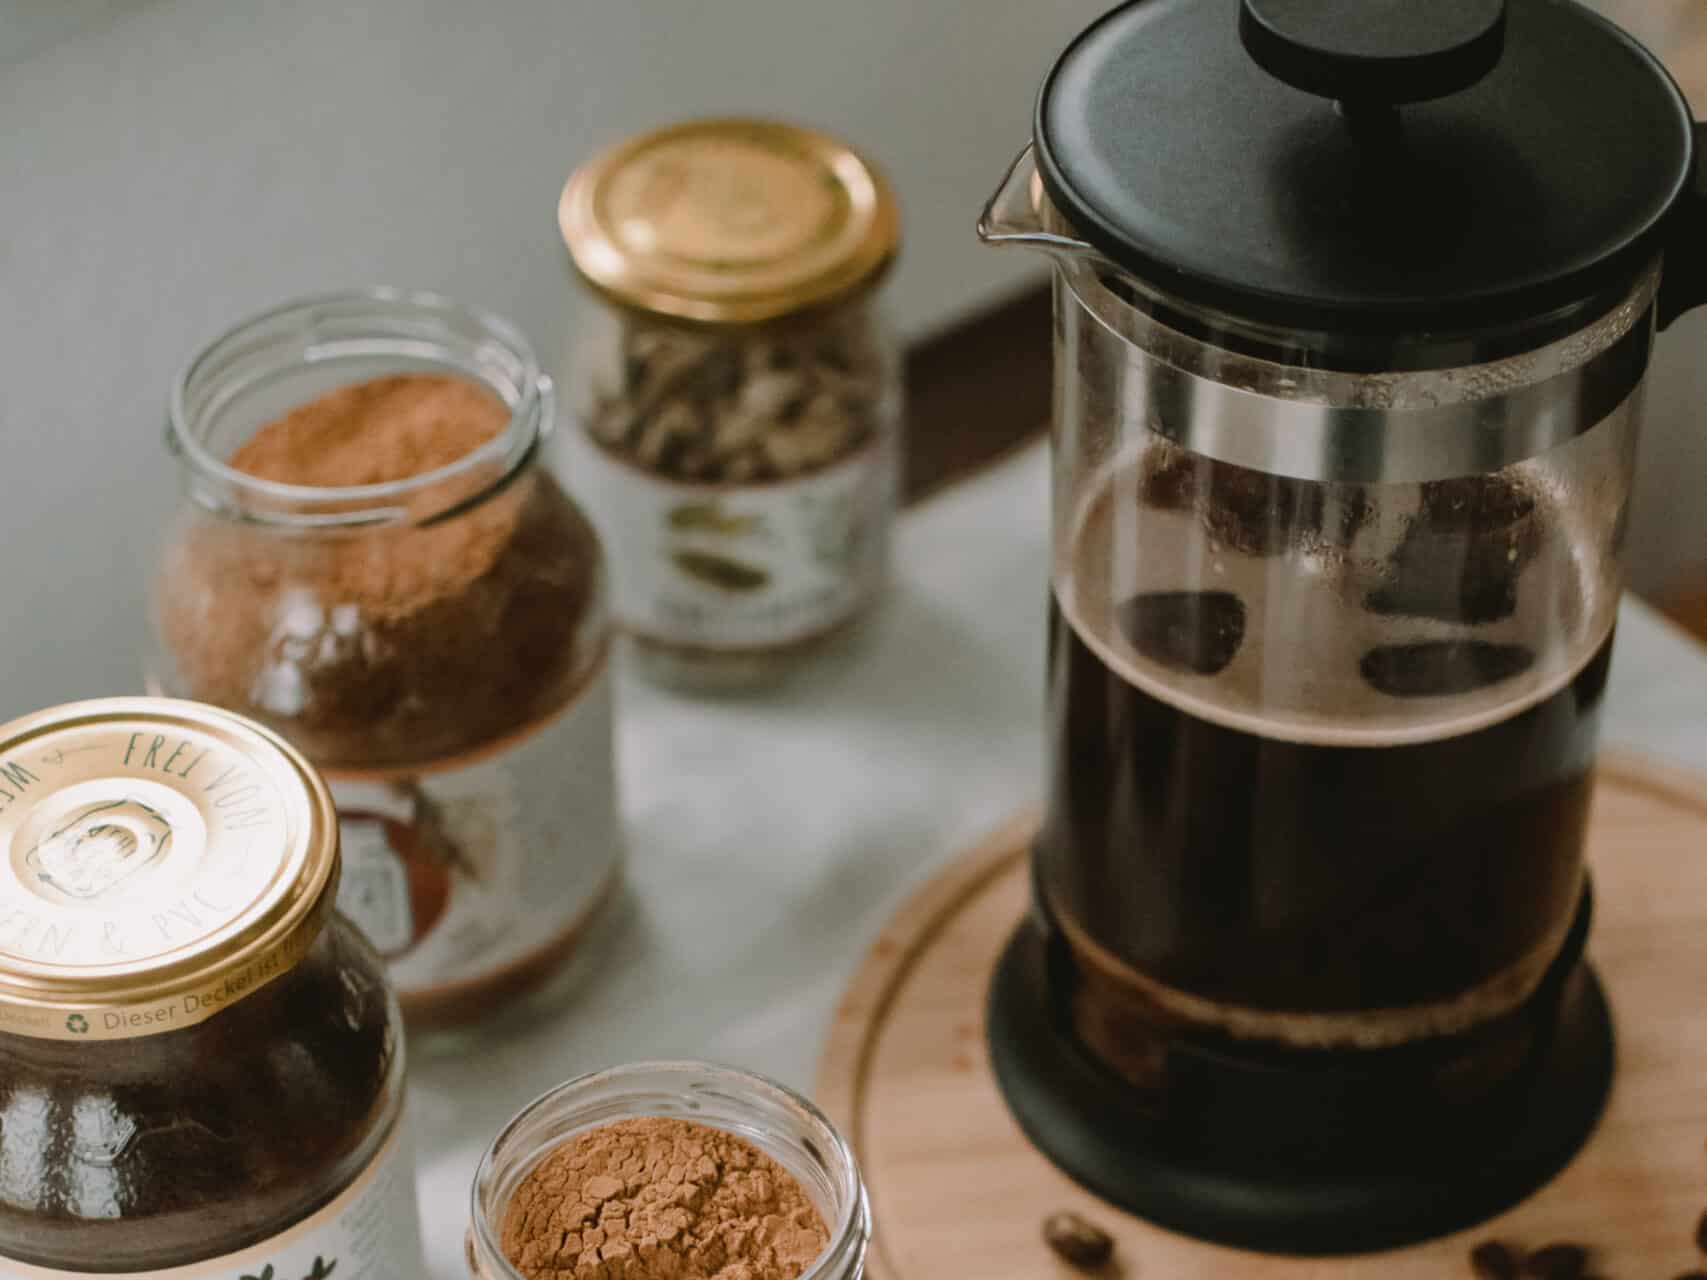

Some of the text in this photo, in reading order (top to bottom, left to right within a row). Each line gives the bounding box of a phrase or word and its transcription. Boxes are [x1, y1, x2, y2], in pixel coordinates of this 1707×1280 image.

[124, 732, 212, 779] FREI
[104, 1005, 176, 1030] Dieser
[183, 970, 253, 1015] Deckel
